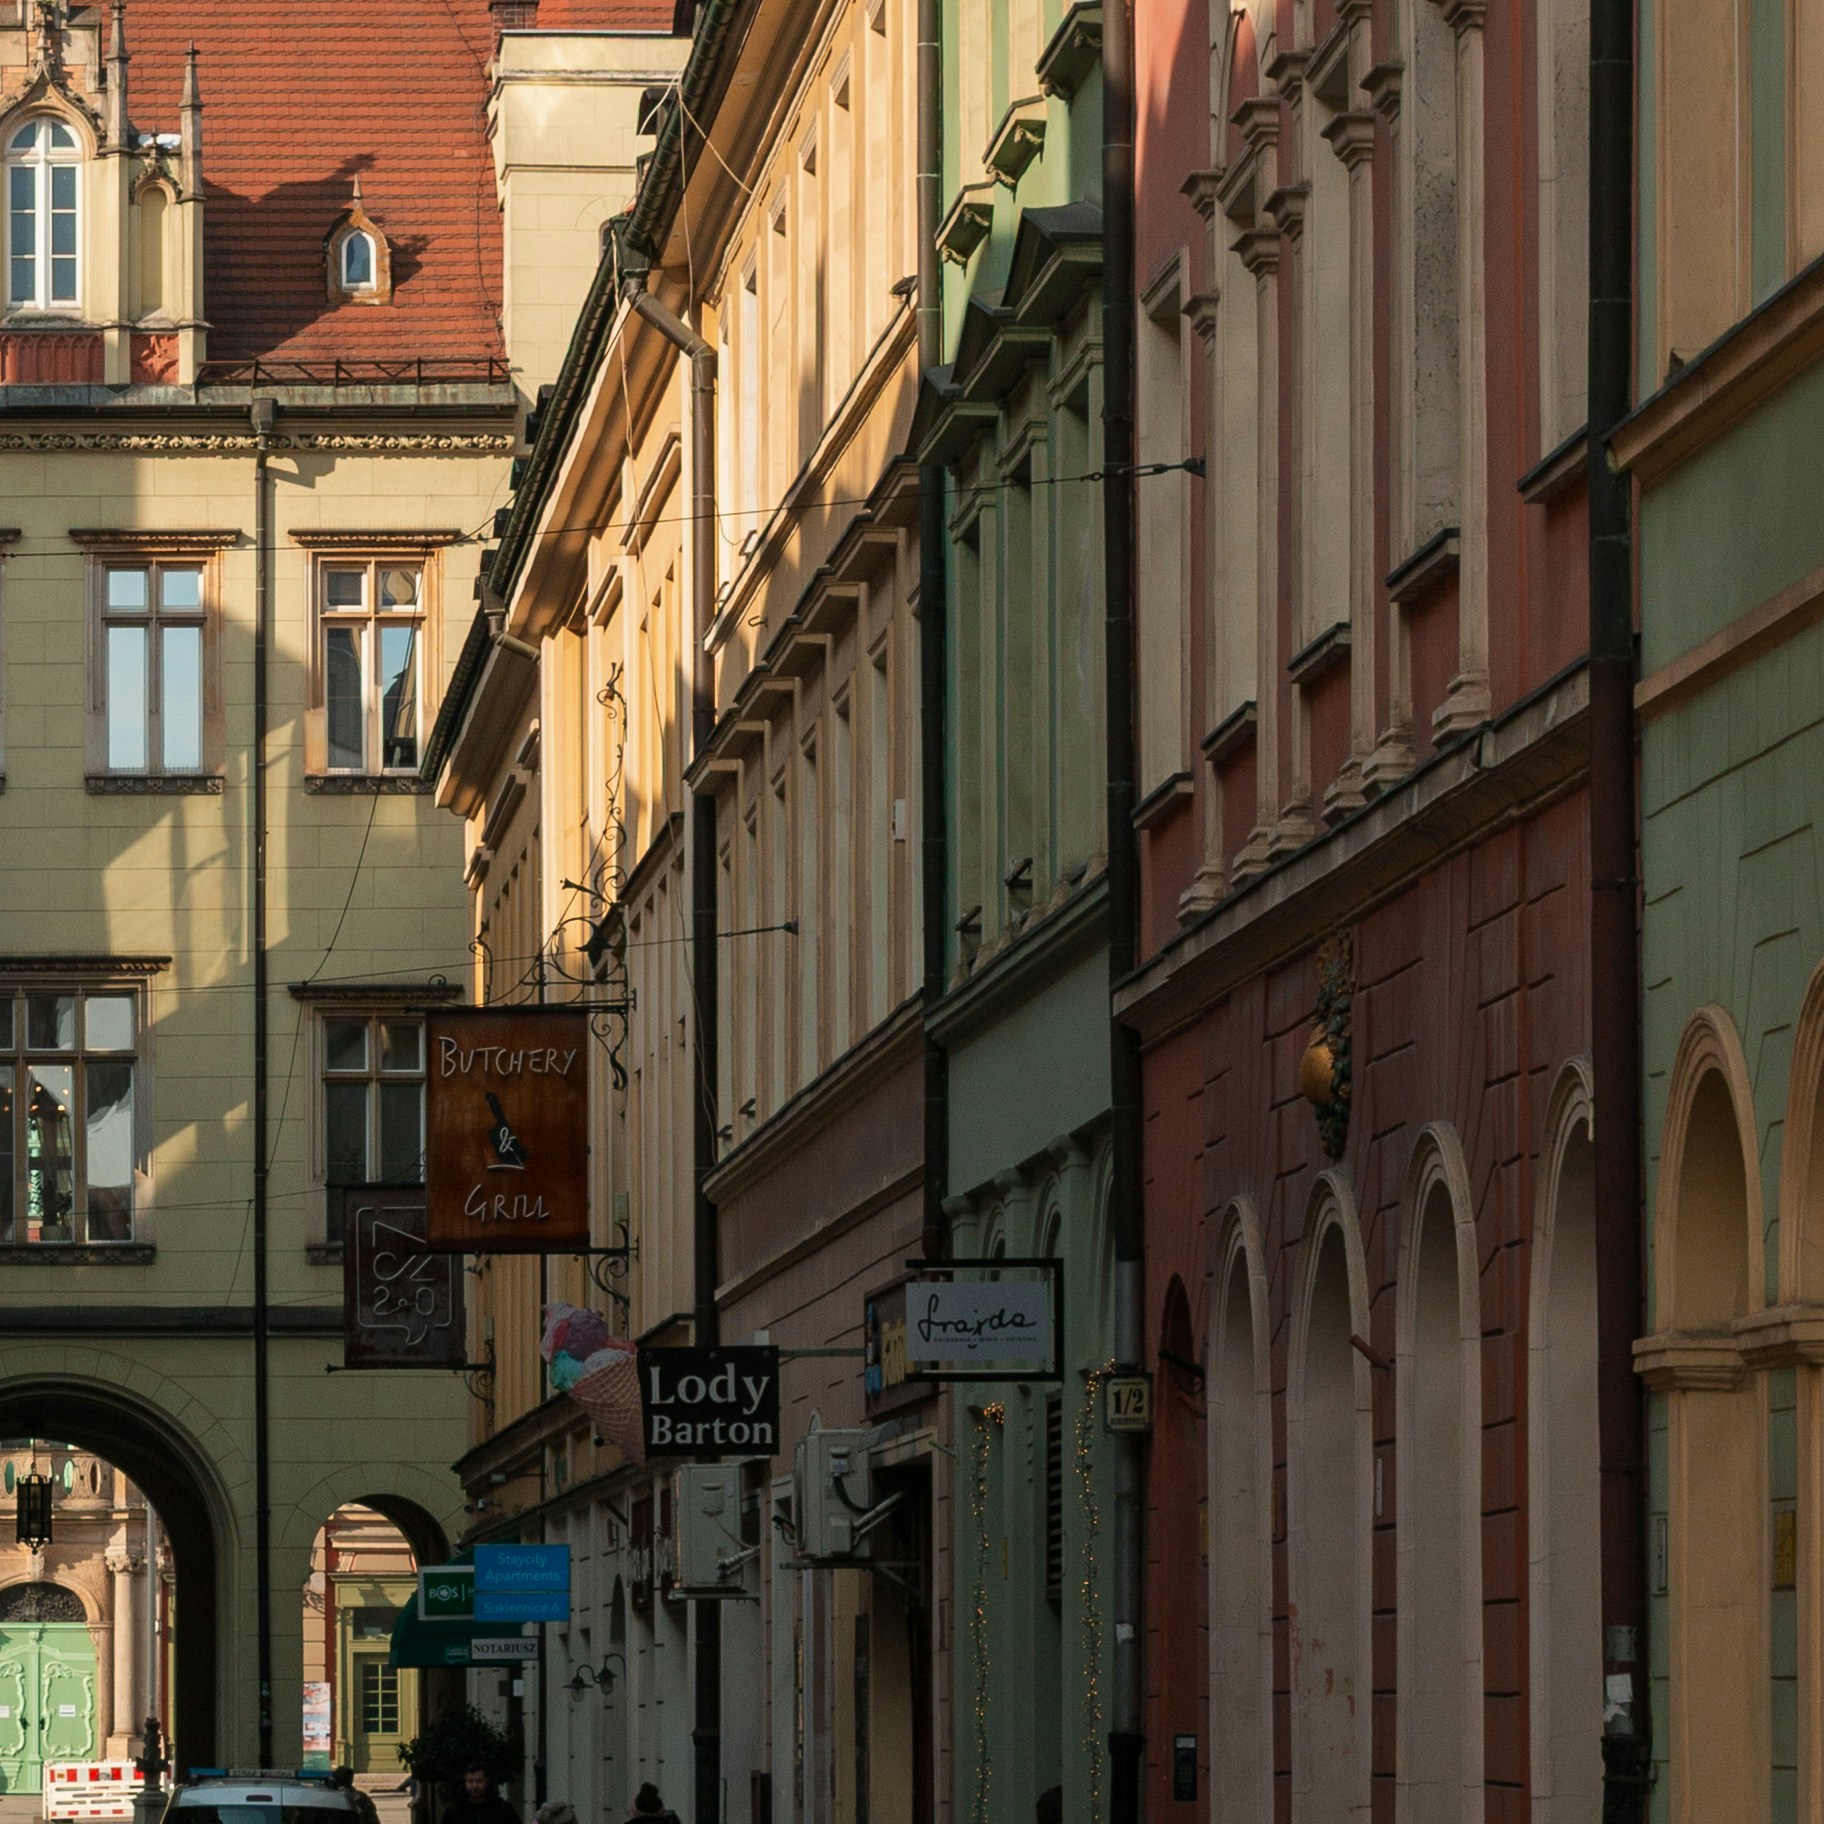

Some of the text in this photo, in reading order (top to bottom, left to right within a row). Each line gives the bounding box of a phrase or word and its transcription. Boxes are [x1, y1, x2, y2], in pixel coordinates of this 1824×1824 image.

[437, 1036, 576, 1077] BUTCHERY
[649, 1362, 771, 1415] Lody
[1112, 1387, 1144, 1415] 1/2
[650, 1415, 773, 1445] Barton
[498, 1552, 547, 1567] Staycity
[485, 1571, 560, 1584] Apartments
[484, 1602, 560, 1614] Sukiennice 6
[473, 1643, 537, 1654] NOTARIUSZ
